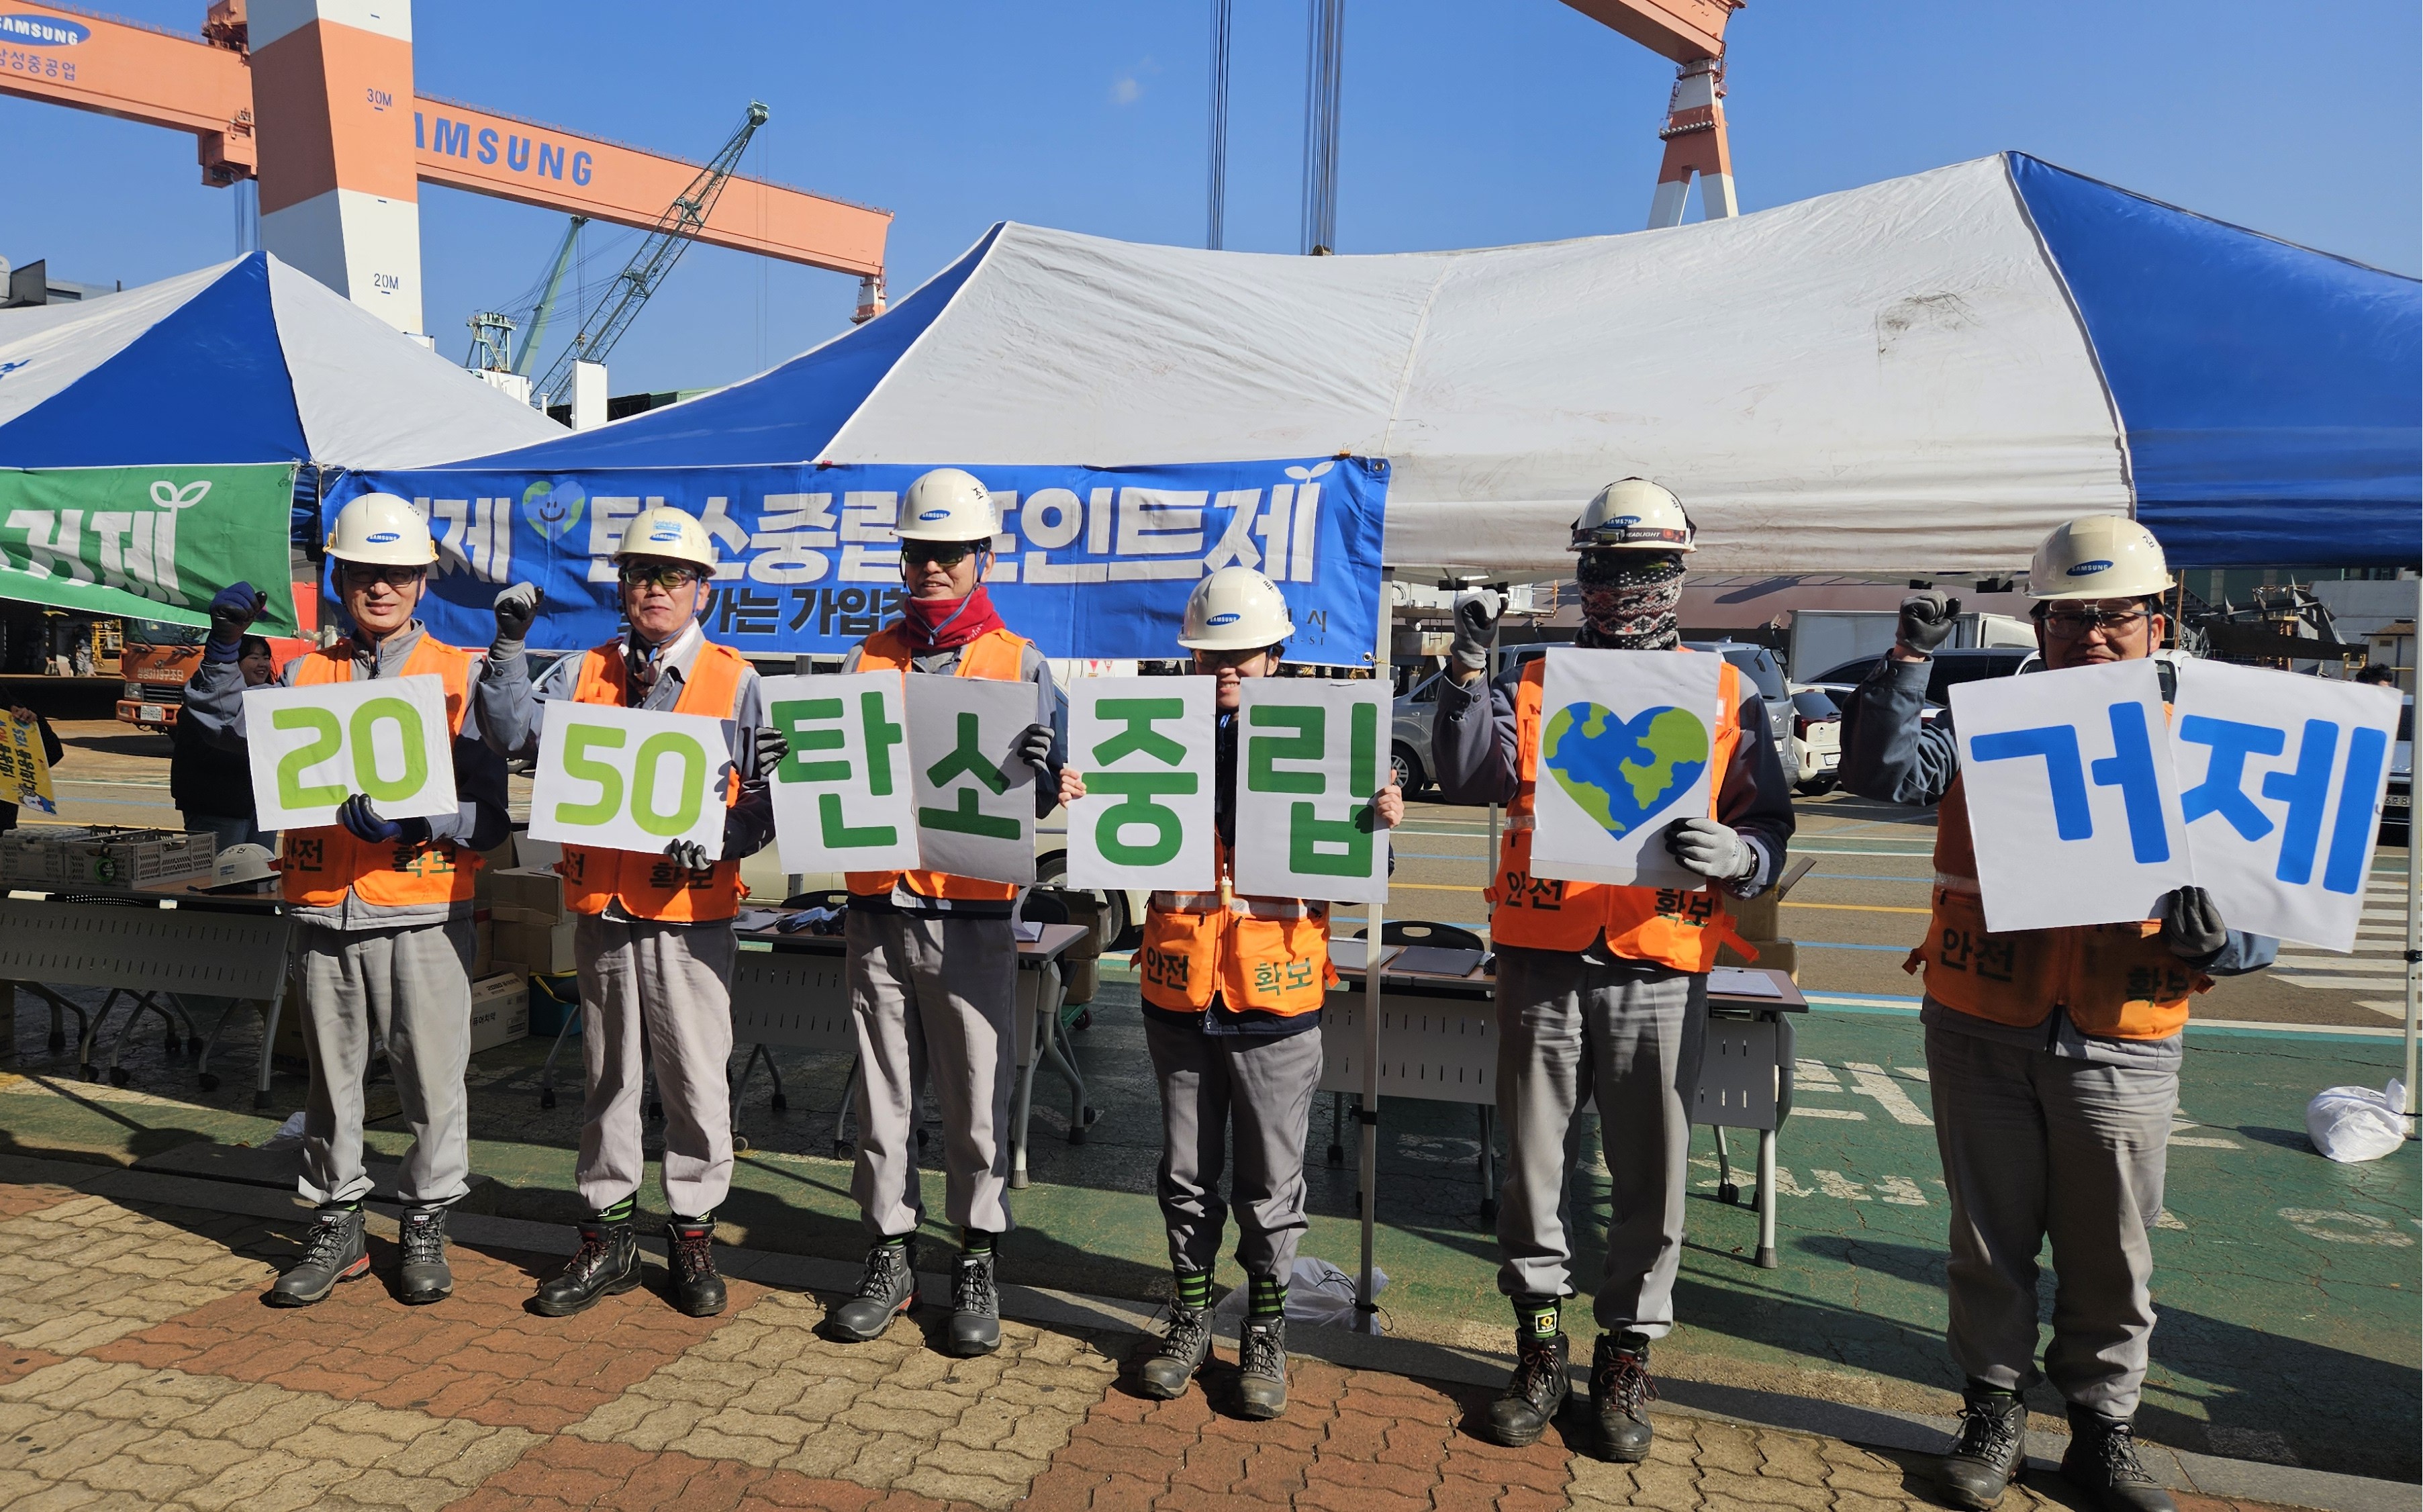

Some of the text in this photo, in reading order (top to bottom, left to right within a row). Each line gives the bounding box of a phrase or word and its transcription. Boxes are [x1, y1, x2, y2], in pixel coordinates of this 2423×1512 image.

[0, 17, 78, 46] AMSUNG
[367, 89, 392, 107] 30M
[374, 273, 398, 290] 20M
[5, 508, 190, 605] 거제
[2072, 564, 2109, 572] SAMSUNG
[12, 728, 29, 748] YES
[272, 697, 428, 810] 20
[555, 723, 707, 837] 50
[2385, 797, 2408, 806] 628
[284, 837, 457, 878] 안전 확보
[1145, 946, 1314, 996] 안전 확보
[1940, 928, 2013, 982] 안전
